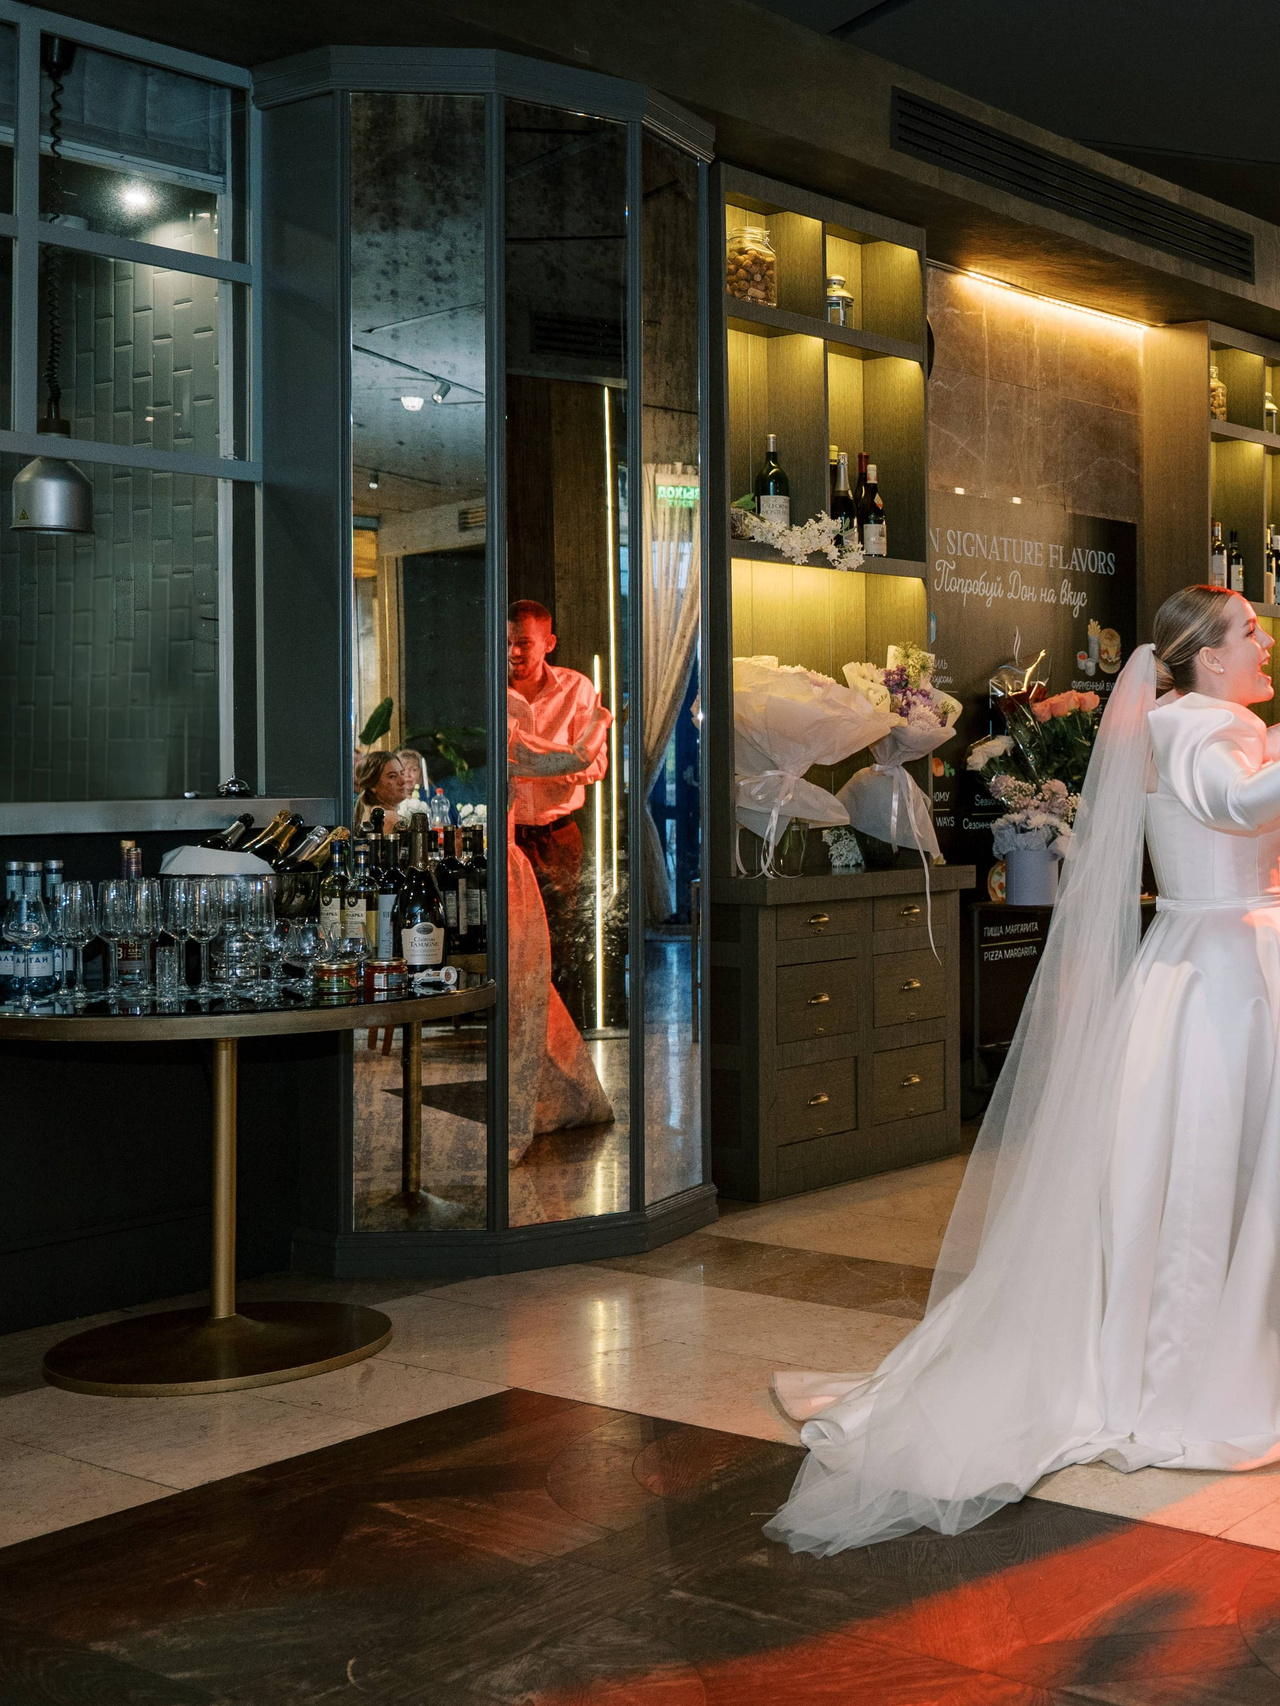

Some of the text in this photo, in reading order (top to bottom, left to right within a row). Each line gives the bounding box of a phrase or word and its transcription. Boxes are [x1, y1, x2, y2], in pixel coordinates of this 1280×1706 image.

[946, 529, 1044, 567] SIGNATURE
[1048, 543, 1116, 576] FLAVORS
[934, 559, 1088, 618] Попробуй Дон на вкус
[935, 816, 955, 827] WAYS
[983, 921, 1039, 937] ПИЦЦА МАРГАРИТА
[983, 945, 1038, 962] PIZZA MARGARITA
